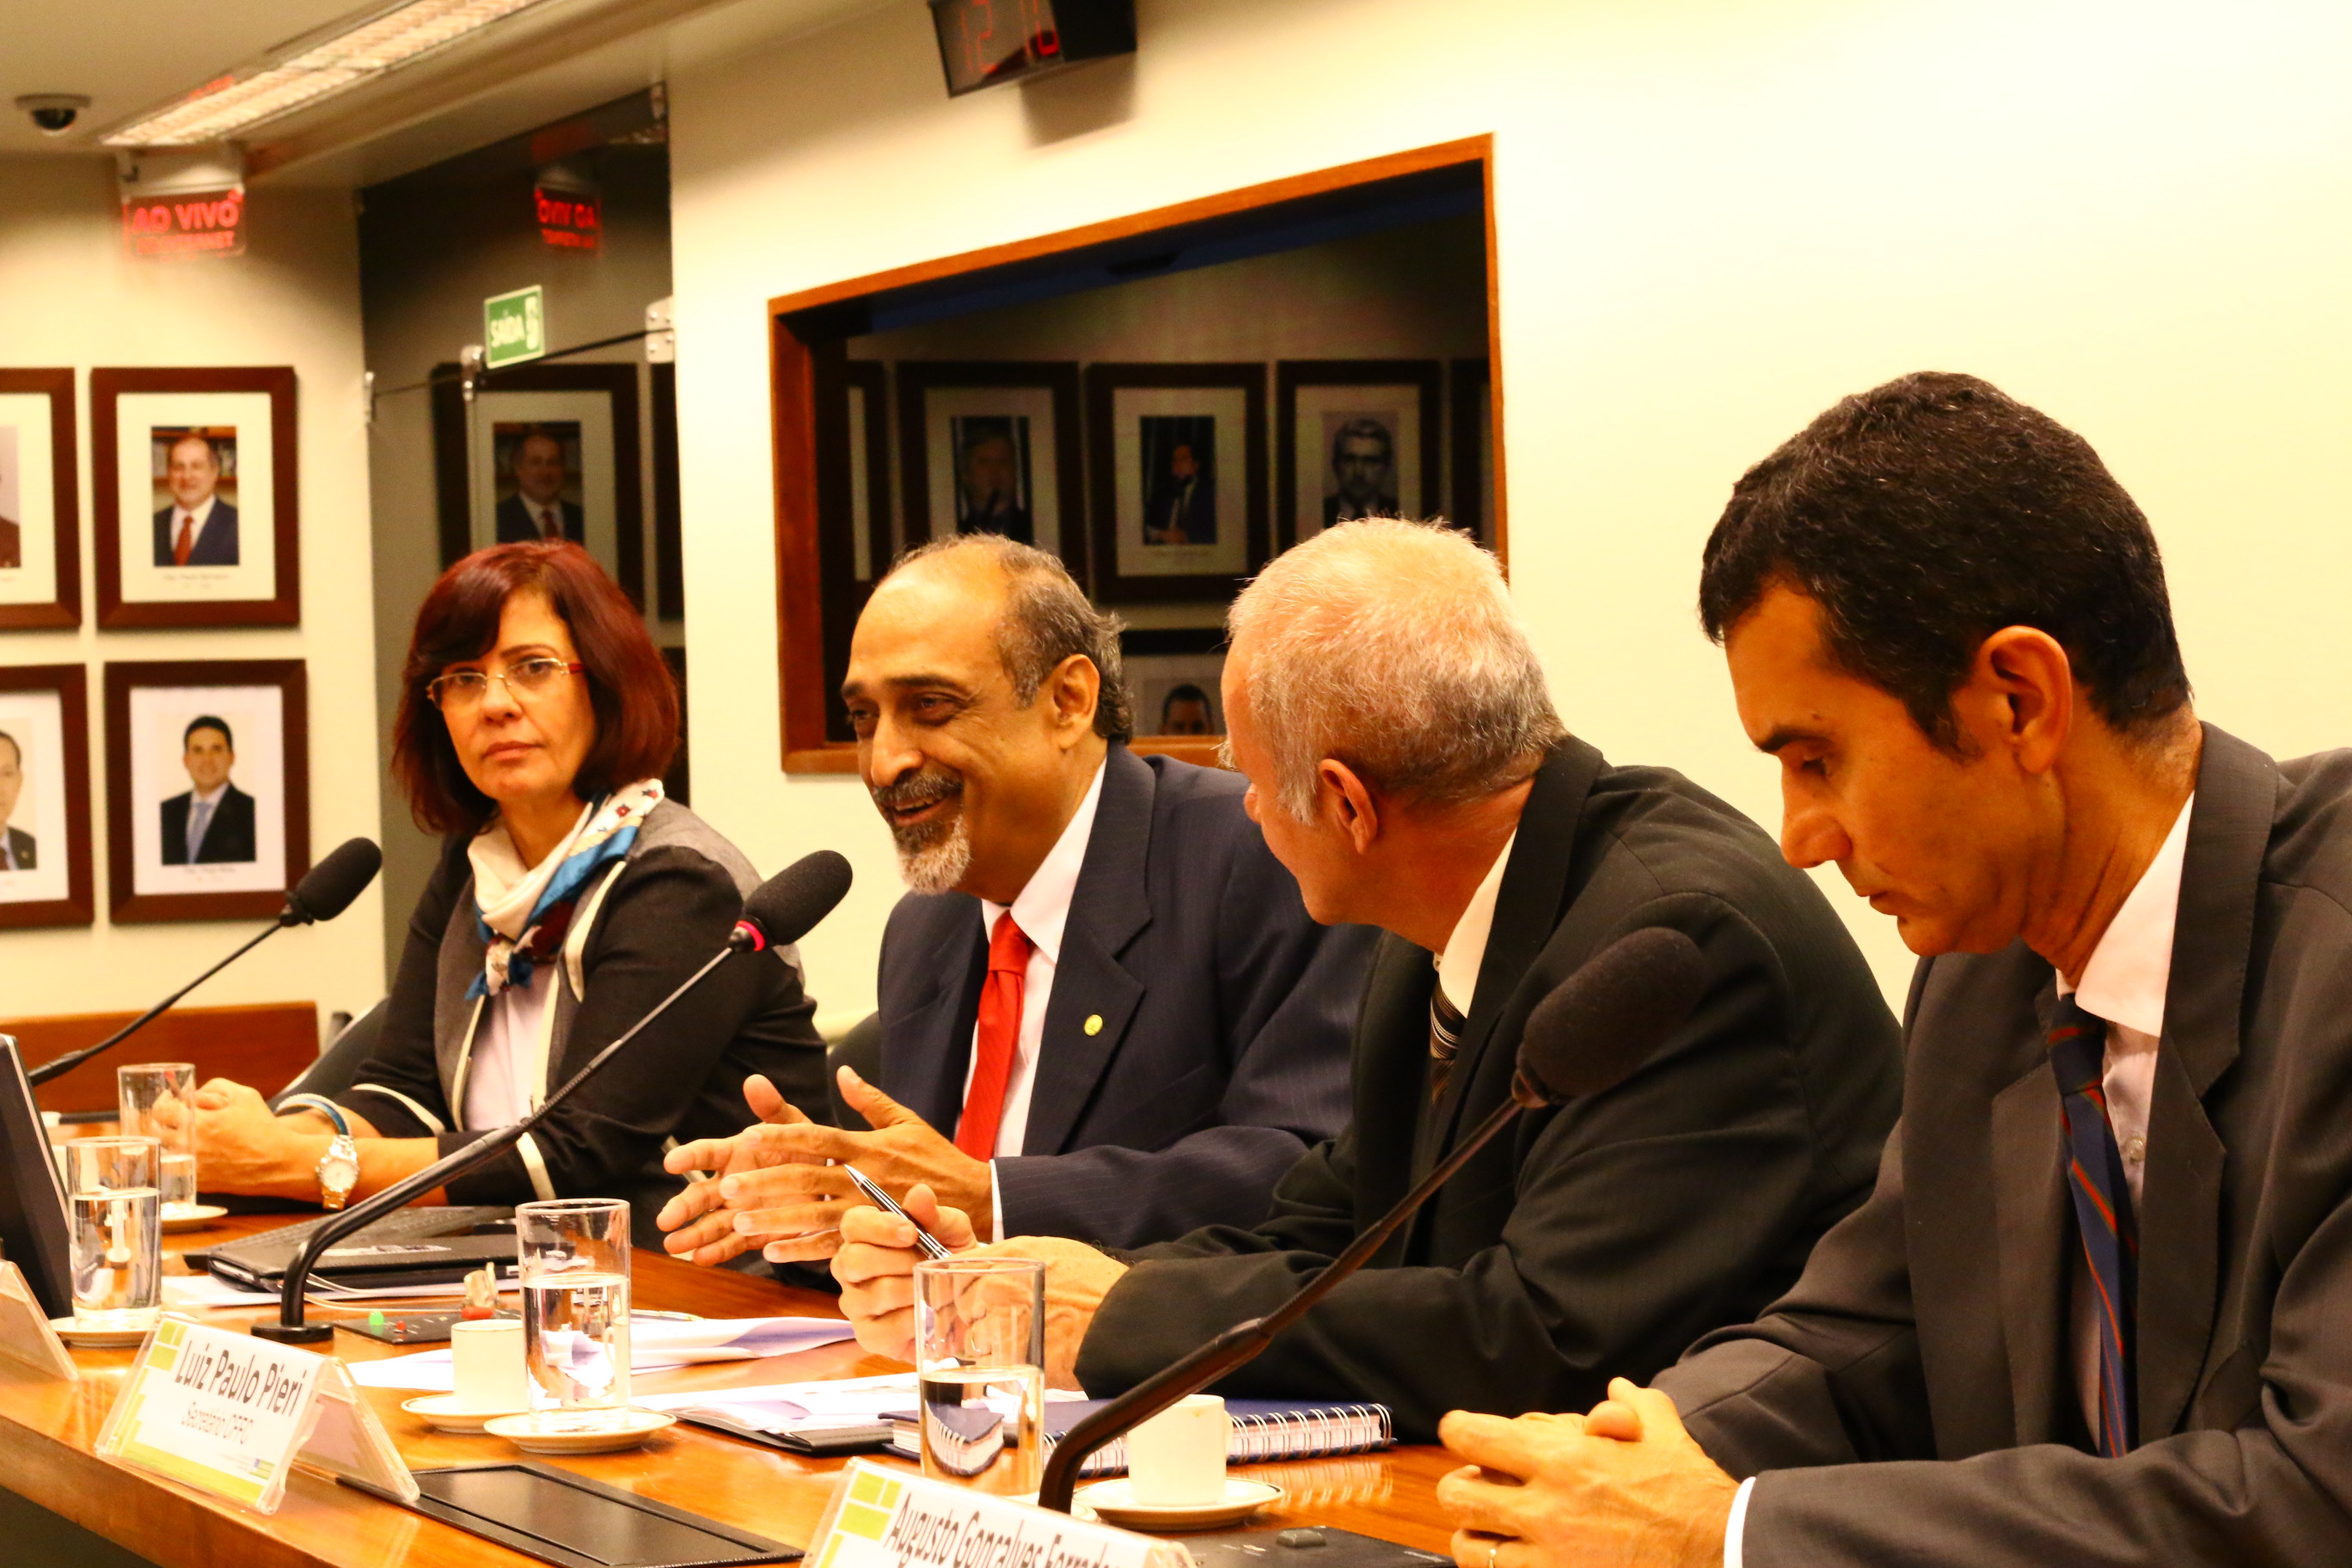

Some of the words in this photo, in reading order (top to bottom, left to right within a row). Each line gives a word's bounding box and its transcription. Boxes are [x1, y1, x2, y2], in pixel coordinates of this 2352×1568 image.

[132, 205, 171, 234] AO
[175, 199, 239, 230] VIVO
[175, 1339, 213, 1390] Luiz
[208, 1349, 260, 1404] Paulo
[256, 1363, 308, 1417] Pieri
[883, 1492, 959, 1568] Augusto
